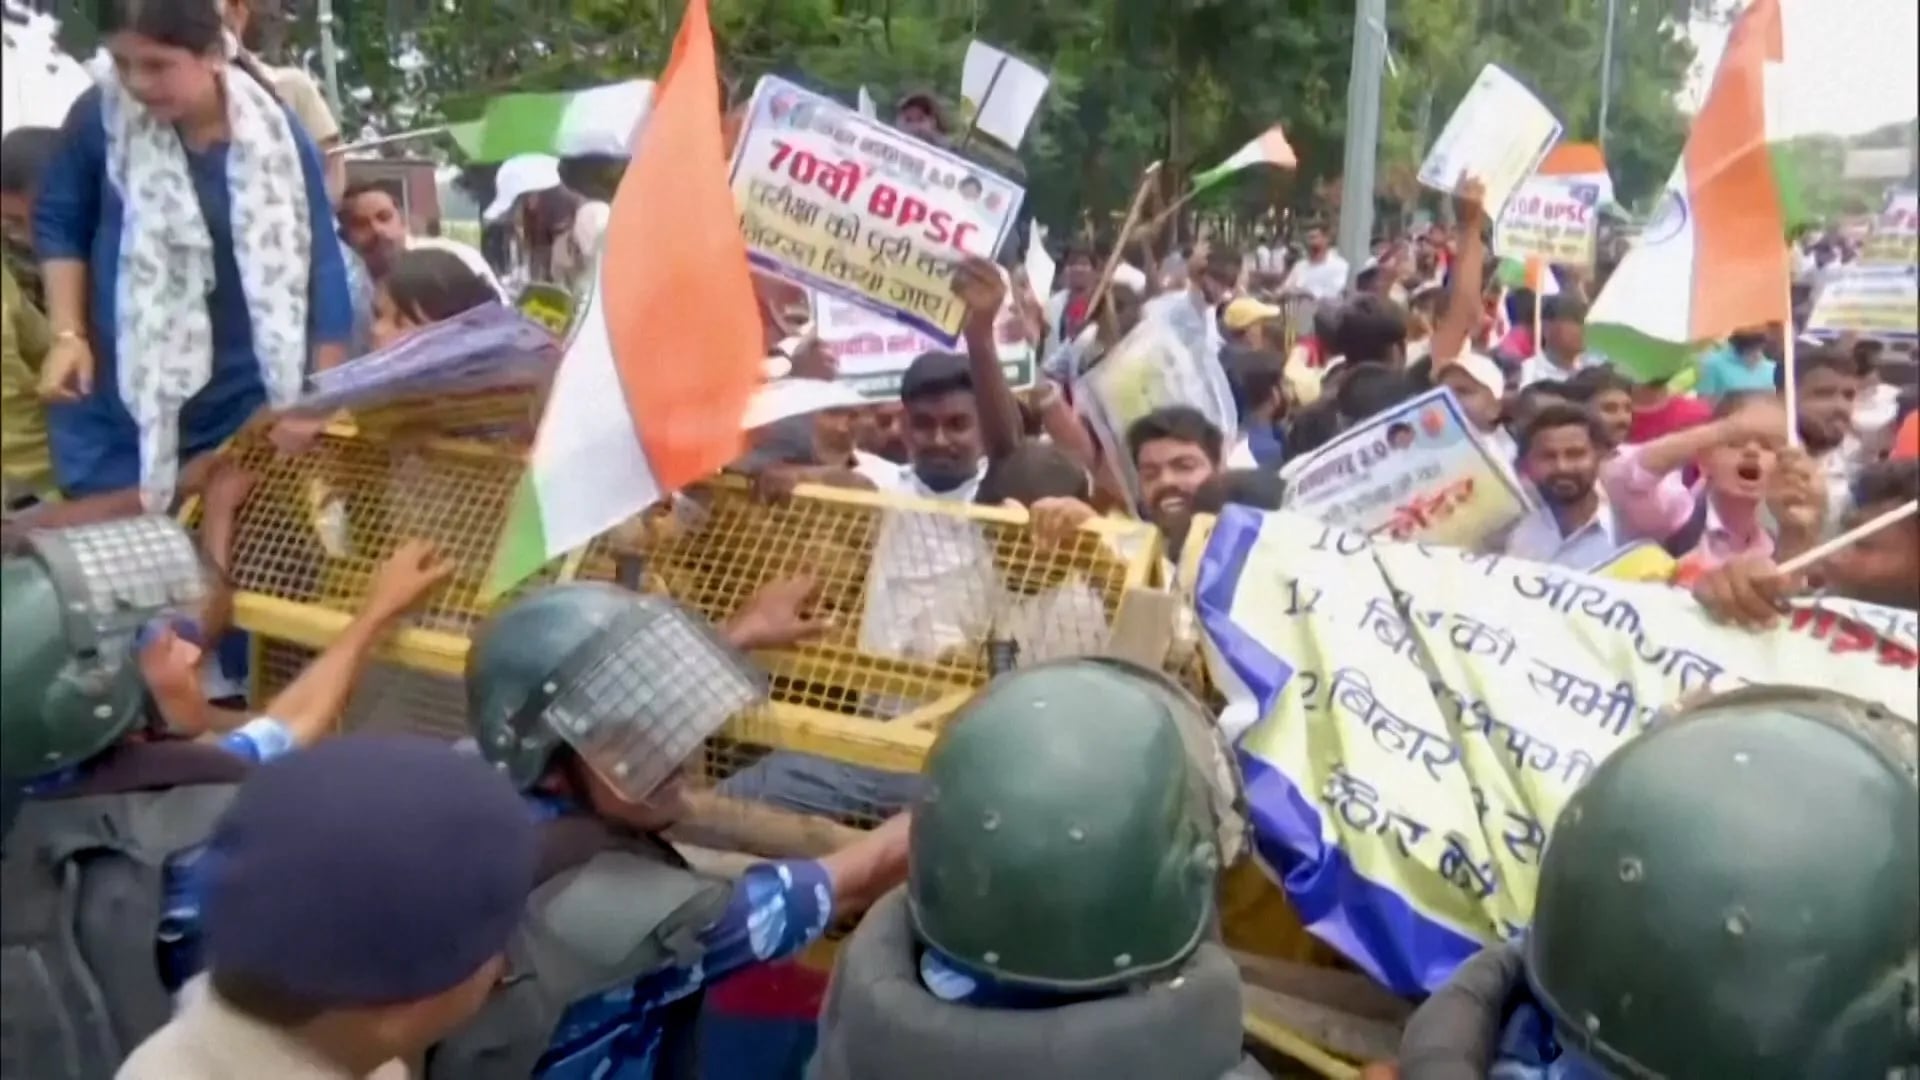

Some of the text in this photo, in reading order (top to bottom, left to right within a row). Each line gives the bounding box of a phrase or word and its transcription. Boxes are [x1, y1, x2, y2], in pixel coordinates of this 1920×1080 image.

[749, 178, 953, 280] परीक्षा को पूरी तर
[867, 182, 979, 256] BPSC
[821, 252, 884, 291] किया
[1328, 664, 1464, 783] बिहार
